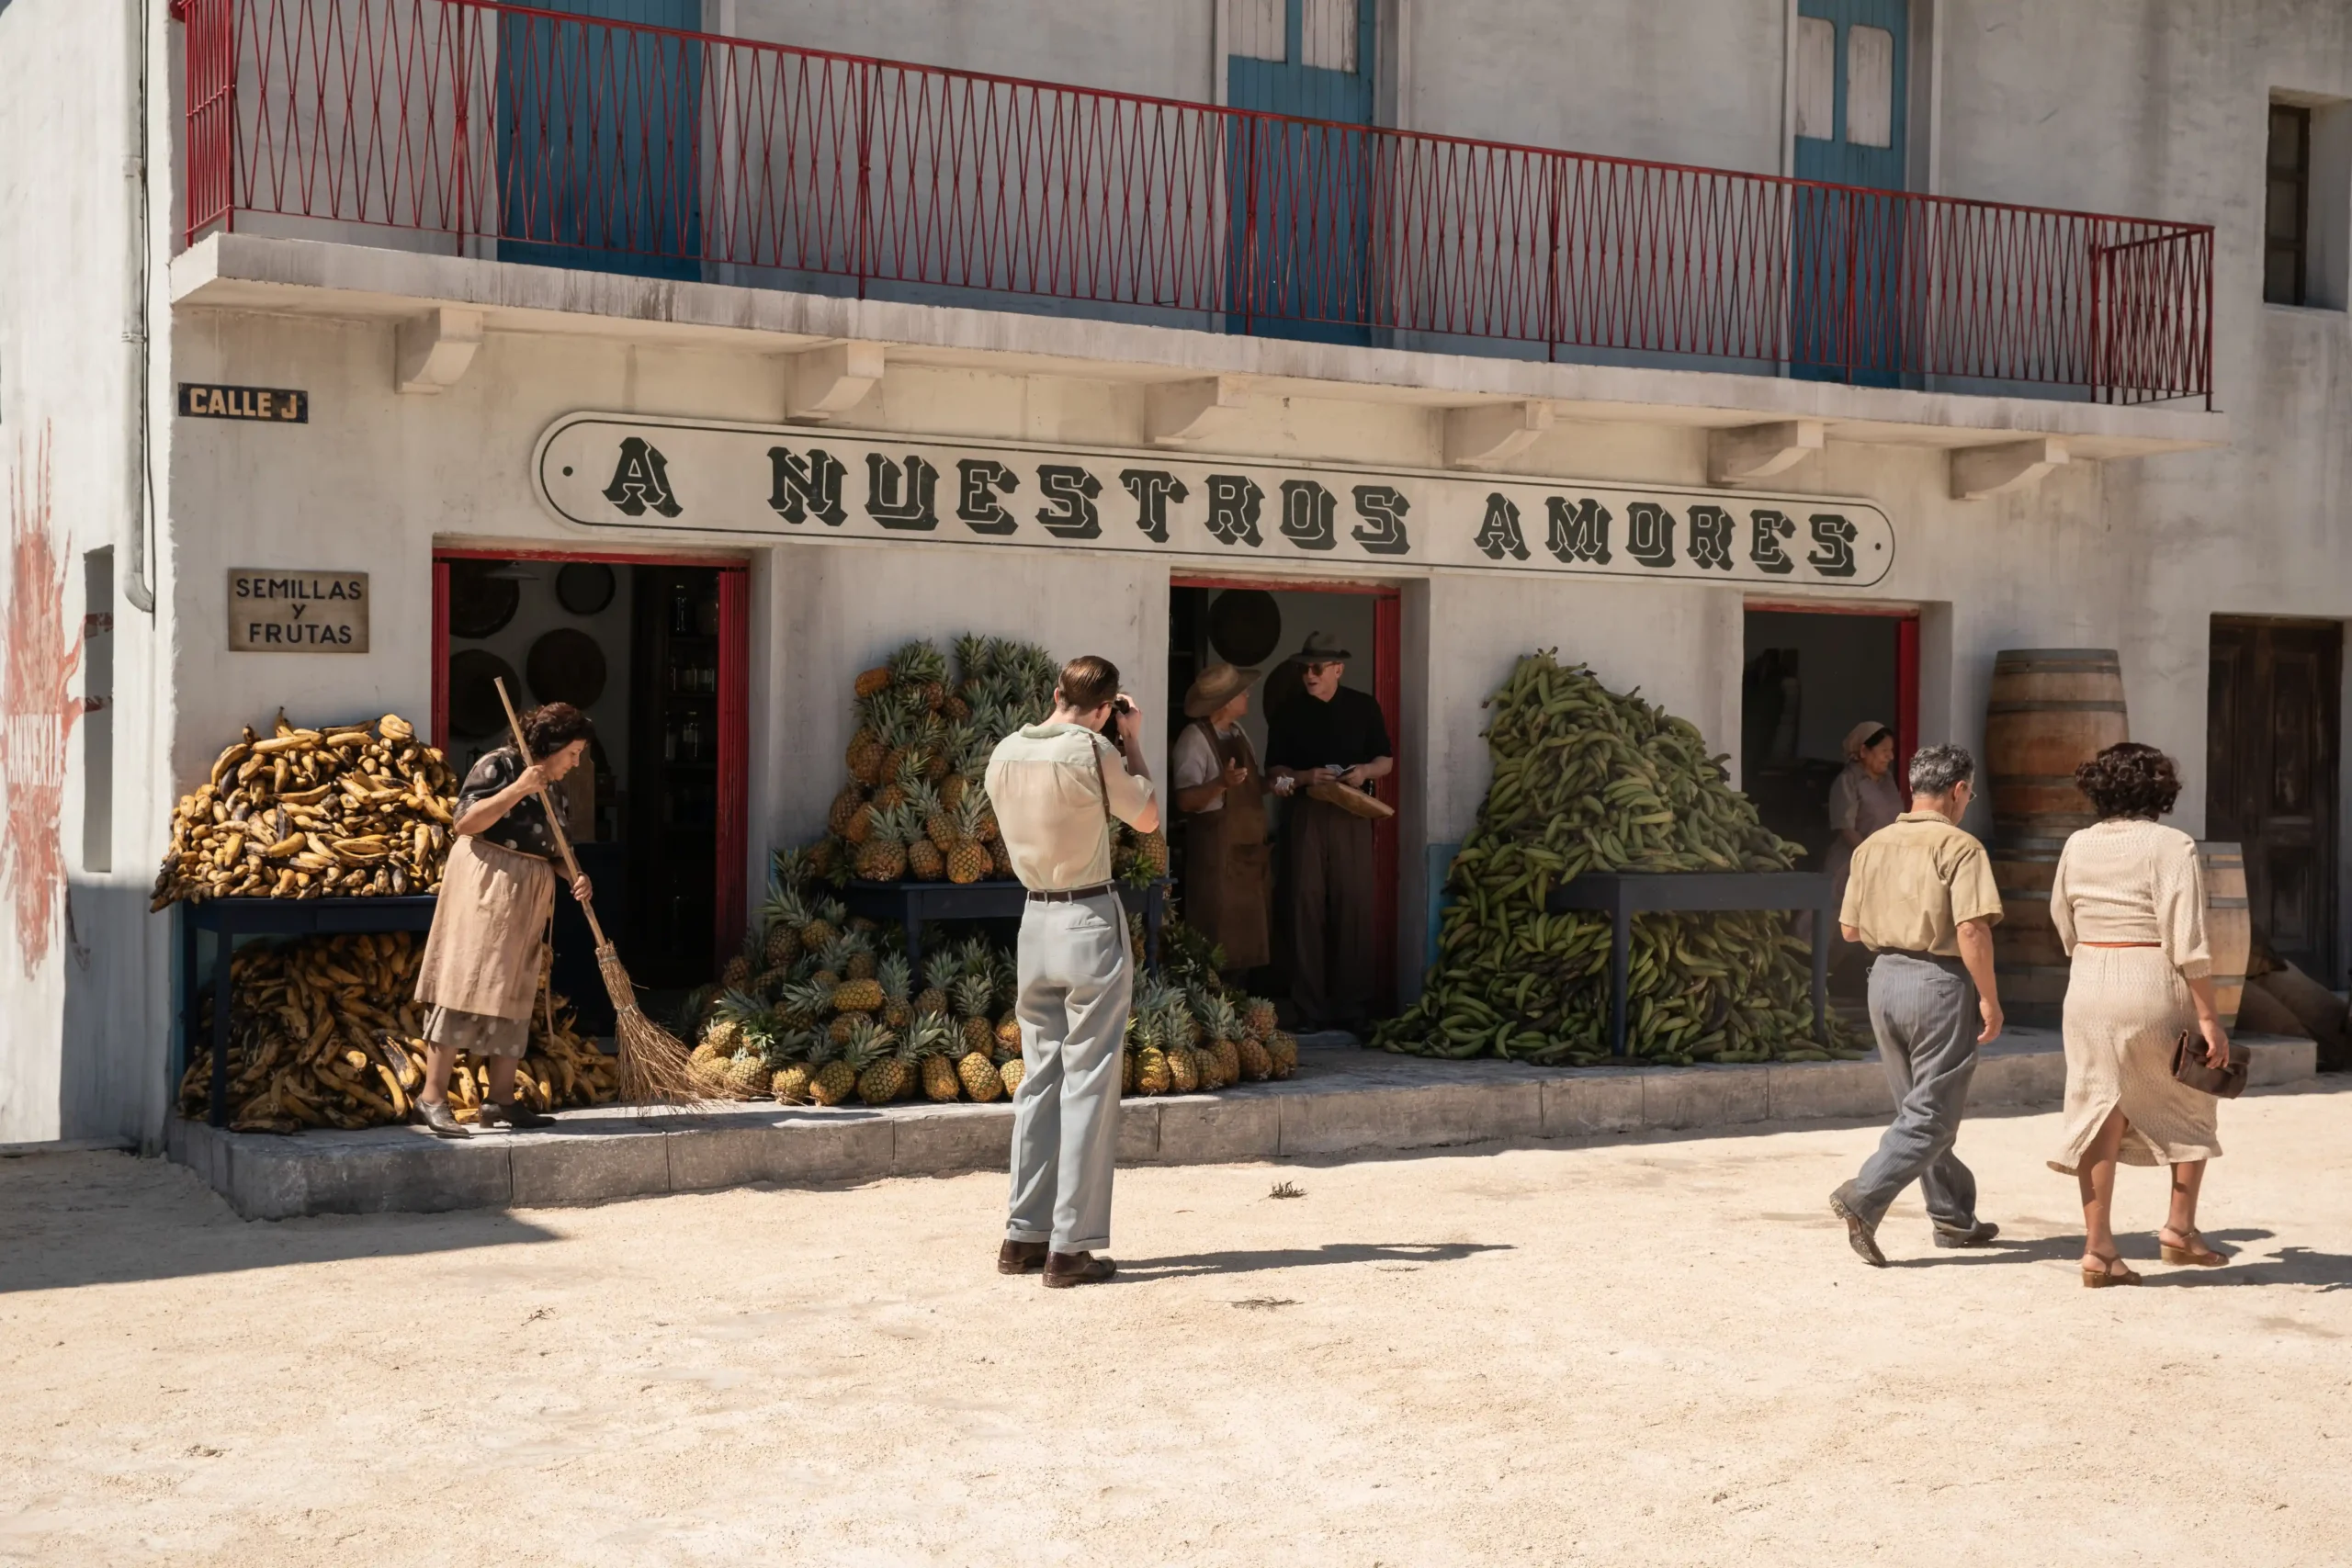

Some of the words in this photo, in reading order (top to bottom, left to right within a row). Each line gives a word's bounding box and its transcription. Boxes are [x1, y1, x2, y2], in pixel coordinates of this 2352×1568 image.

[189, 388, 271, 418] CALLE
[280, 394, 297, 420] J
[601, 436, 684, 518] A
[766, 446, 1412, 555] NUESTROS
[1473, 492, 1859, 578] AMORES
[236, 578, 362, 601] SEMILLAS
[291, 603, 307, 620] Y
[248, 623, 353, 645] FRUTAS
